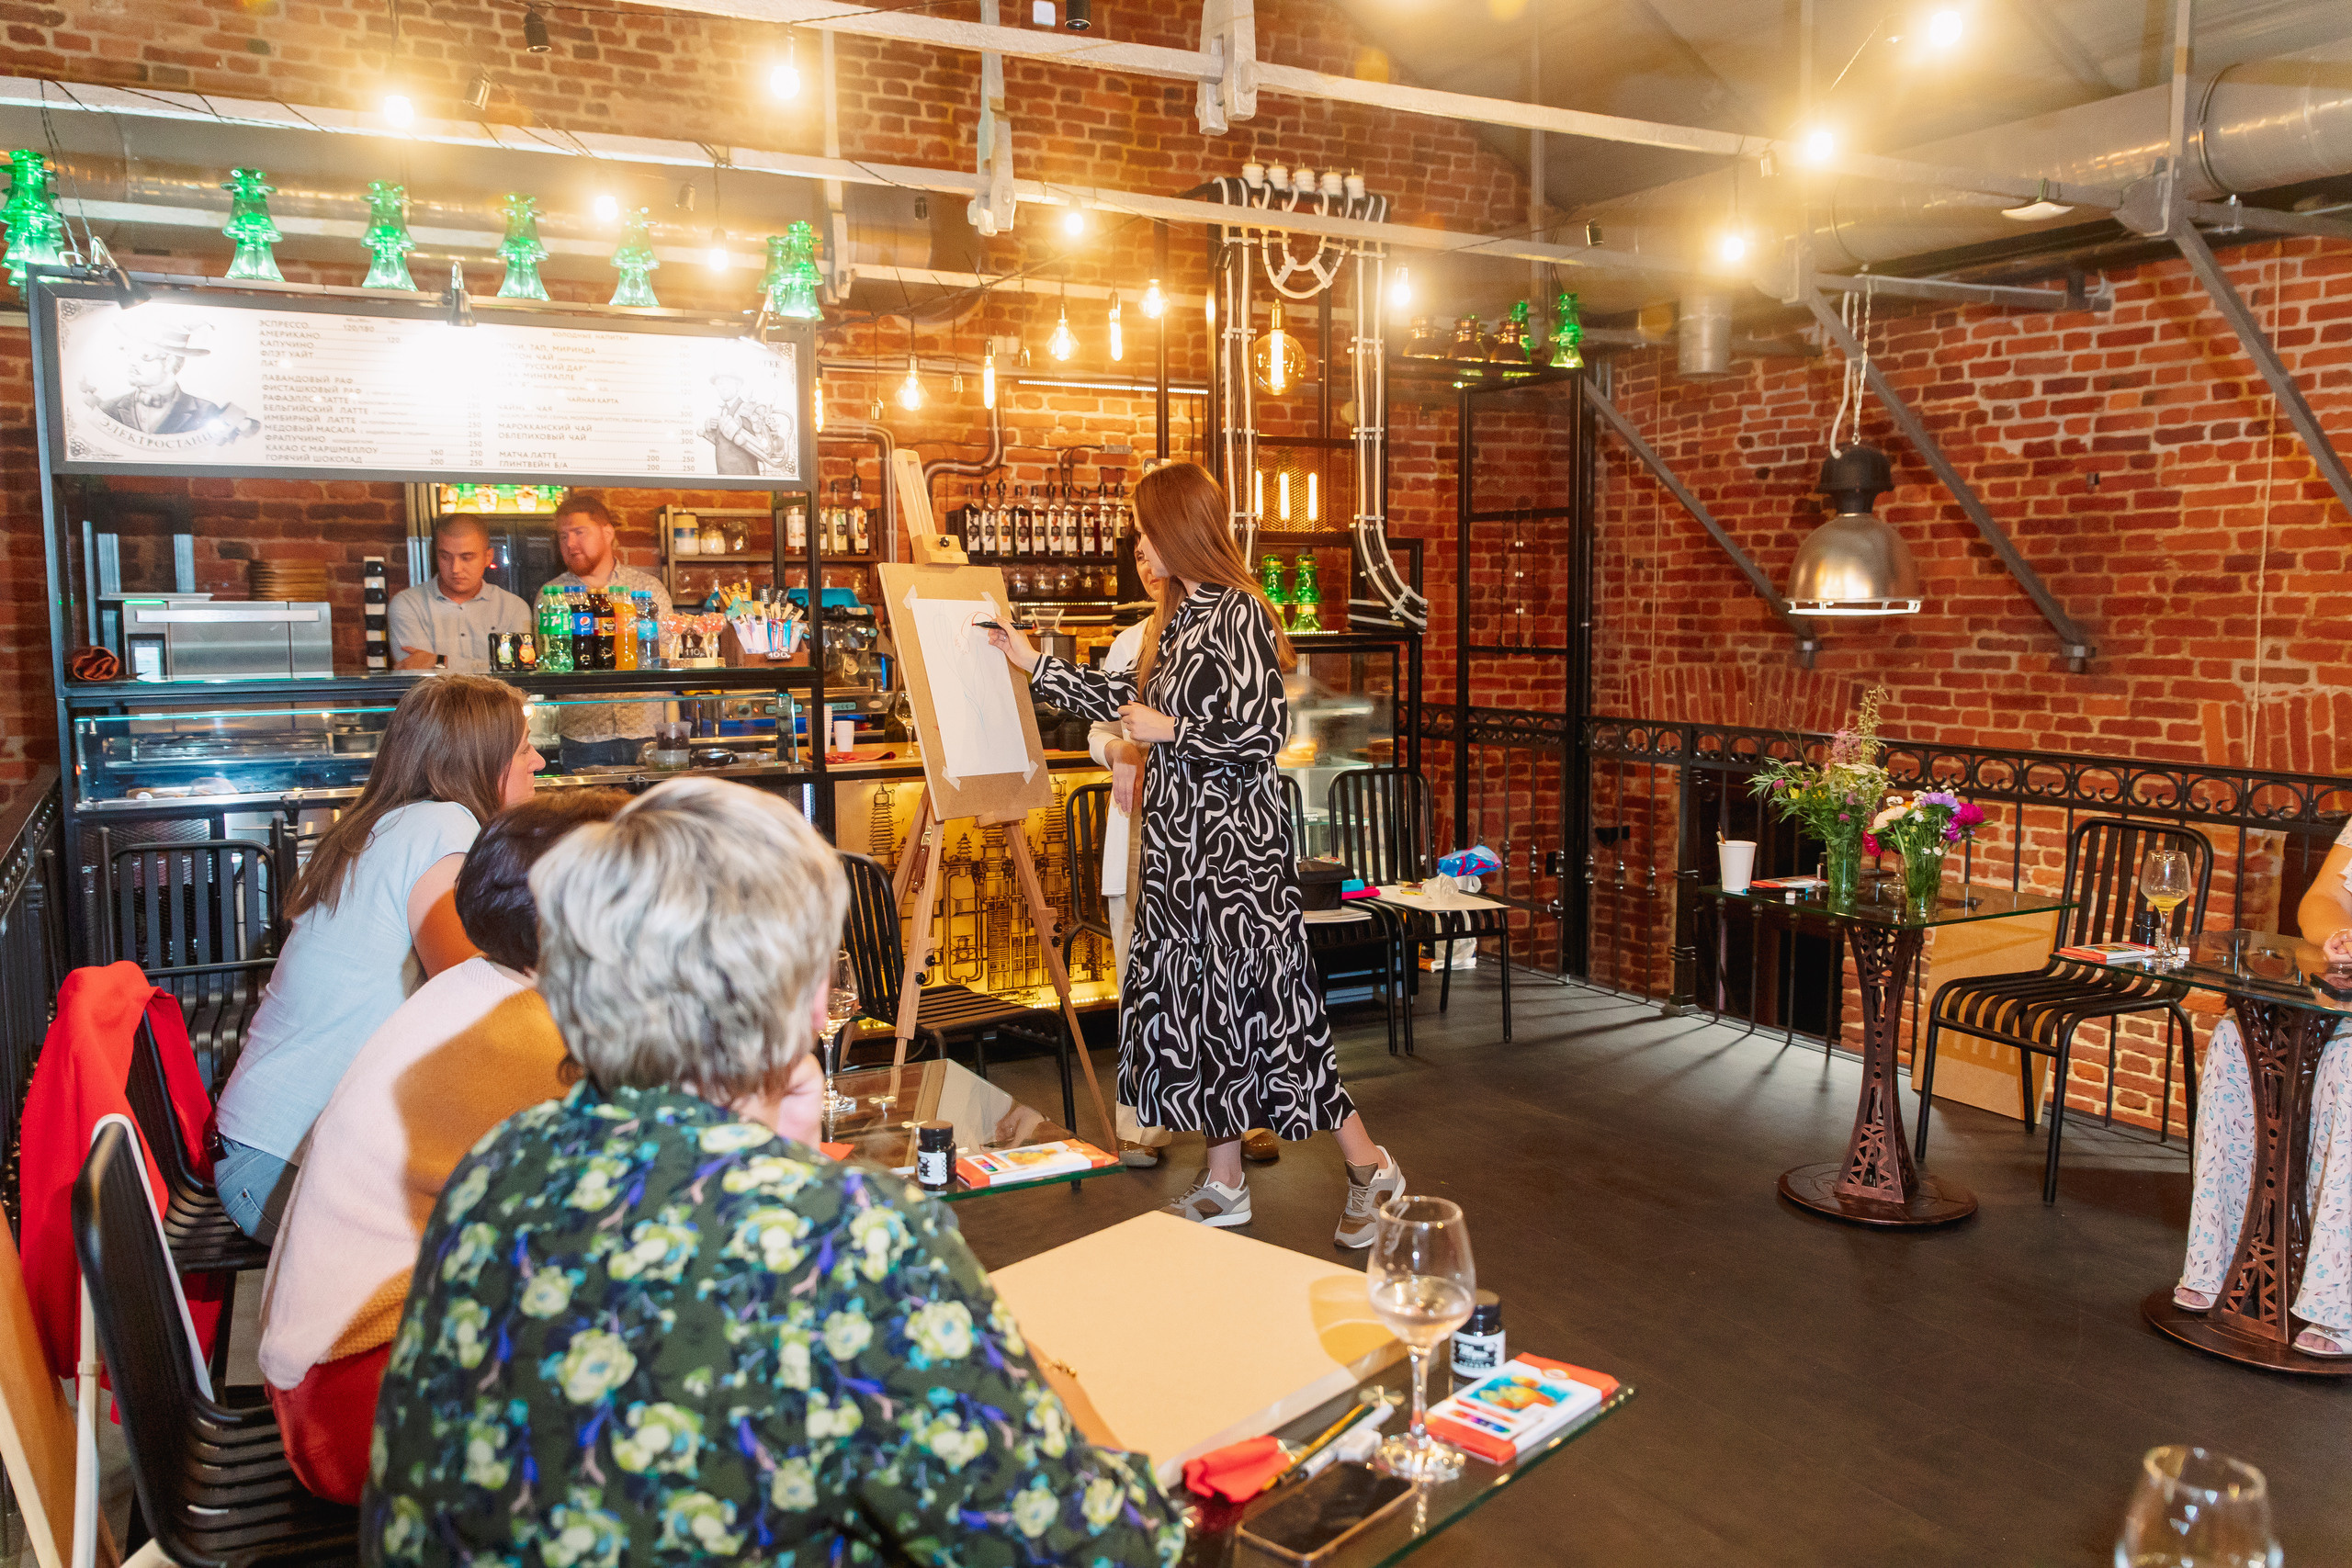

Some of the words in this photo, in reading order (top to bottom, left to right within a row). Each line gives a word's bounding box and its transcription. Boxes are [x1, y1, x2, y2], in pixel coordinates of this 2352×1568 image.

[258, 320, 309, 330] ЭСПРЕССО
[343, 324, 375, 333] 120/180
[258, 330, 321, 340] АМЕРИКАНО
[259, 340, 314, 349] КАПУЧИНО
[552, 345, 596, 354] МИРИНДА
[260, 349, 285, 357] ФЛЭТ
[288, 350, 314, 359] УАЙТ
[261, 374, 331, 384] ЛАВАНДОВЫЙ
[262, 384, 339, 394] ФИСТАШКОВЫЙ
[264, 403, 334, 413] БЕЛЬГИЙСКИЙ
[339, 407, 368, 415] ЛАТТЕ
[264, 413, 321, 423] ИМБИРНЫЙ
[326, 416, 356, 424] ЛАТТЕ
[265, 423, 313, 433] МЕДОВЫЙ
[316, 425, 356, 434] МАСАЛА
[498, 423, 571, 431] МАРОККАНСКИЙ
[265, 434, 326, 443] ФРАПУЧИНО
[498, 432, 566, 441] ОБЛЕПИХОВЫЙ
[309, 446, 379, 454] МАРШМЕЛЛОУ
[266, 454, 311, 462] ГОРЯЧИЙ
[313, 456, 363, 464] ШОКОЛАД
